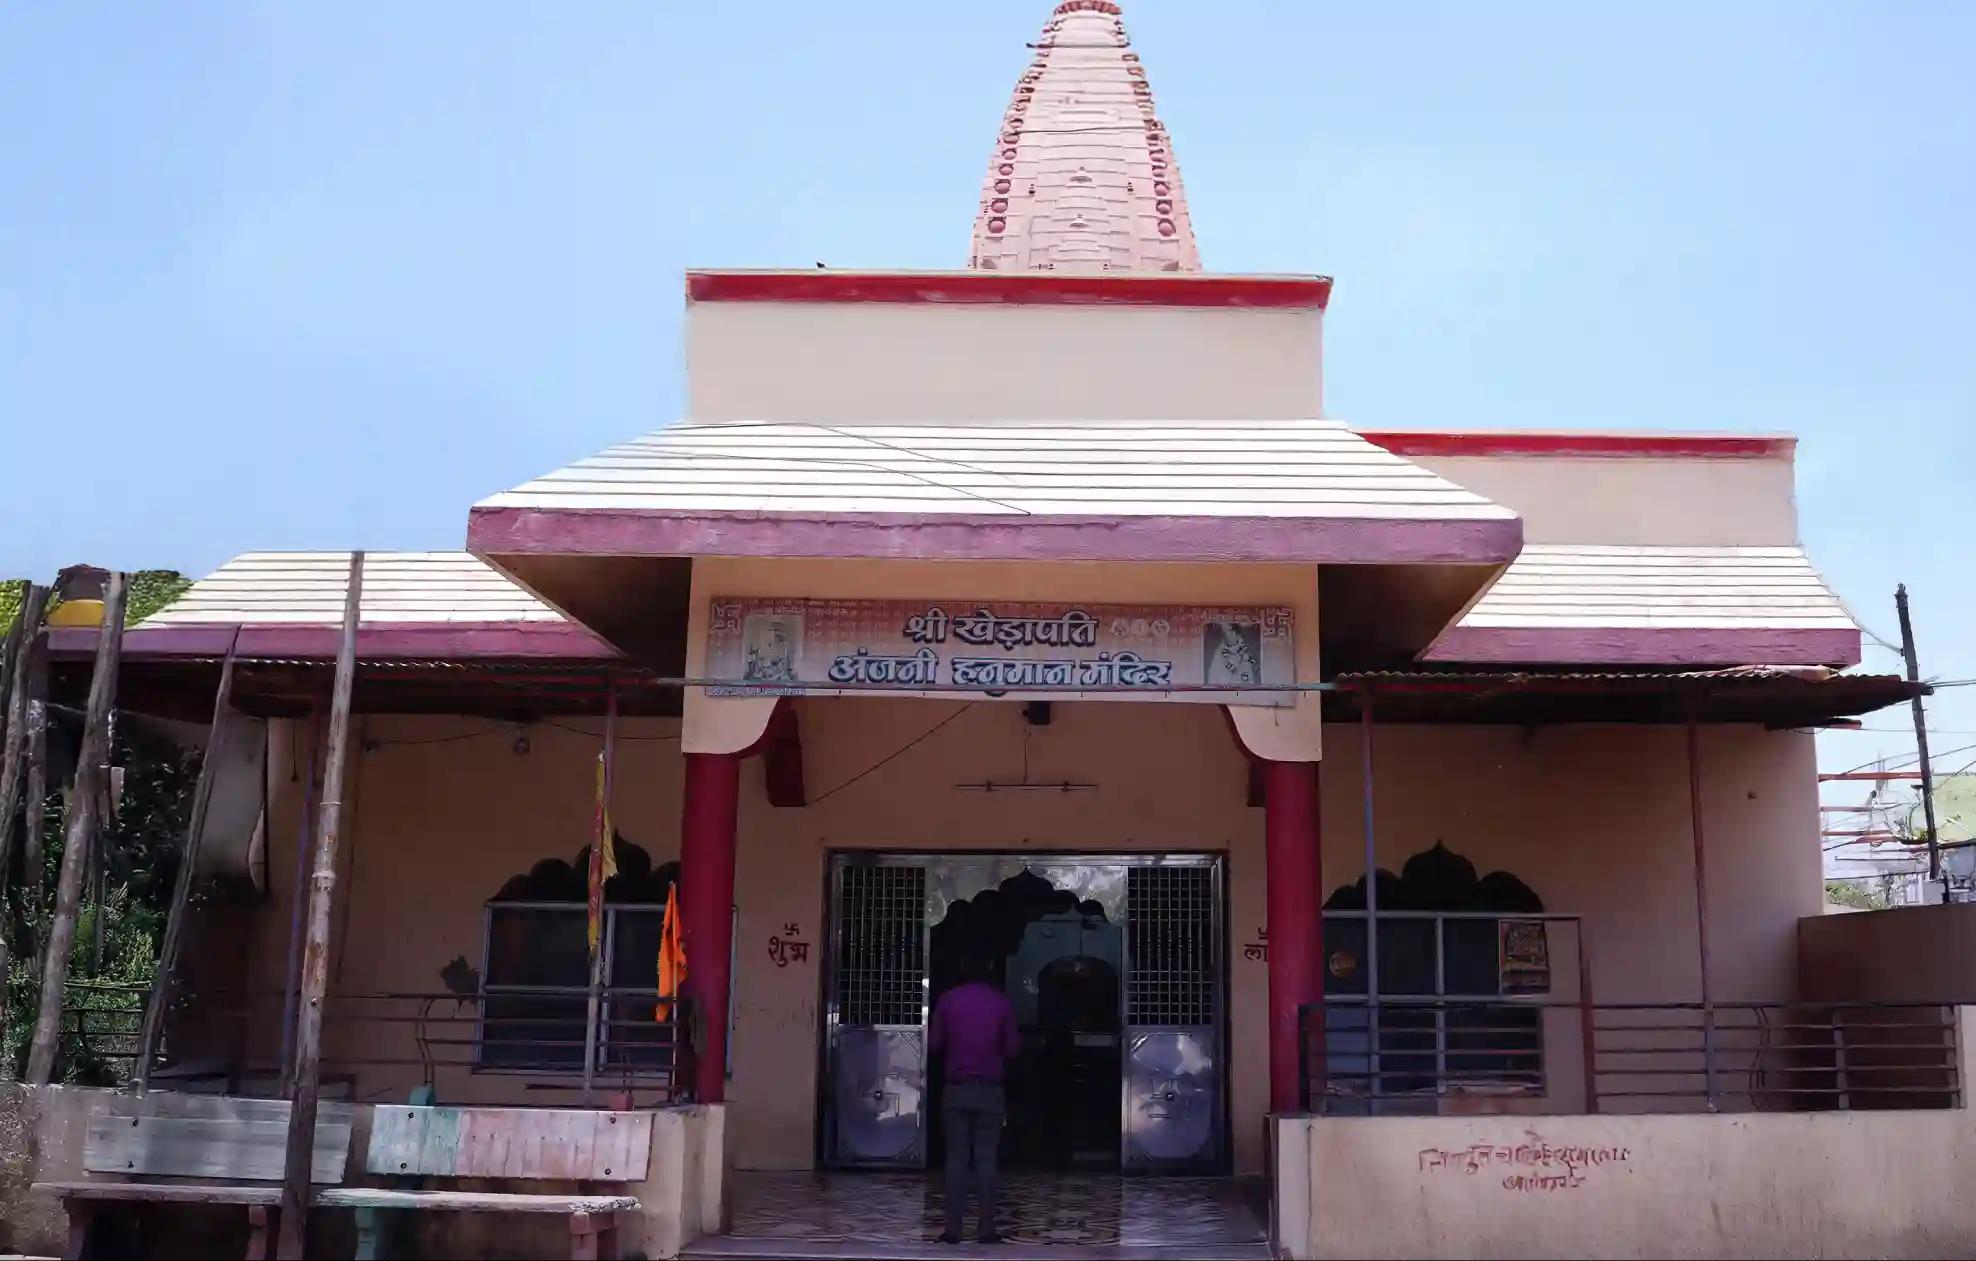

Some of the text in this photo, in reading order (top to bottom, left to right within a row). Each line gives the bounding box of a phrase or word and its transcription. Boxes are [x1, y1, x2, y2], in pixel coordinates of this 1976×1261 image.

[903, 606, 948, 643] श्री
[953, 608, 1100, 650] खेड़ापति
[828, 647, 1172, 697] अंजनी हनुमान मंदिर
[768, 935, 810, 968] शुभ
[1243, 943, 1269, 963] ला
